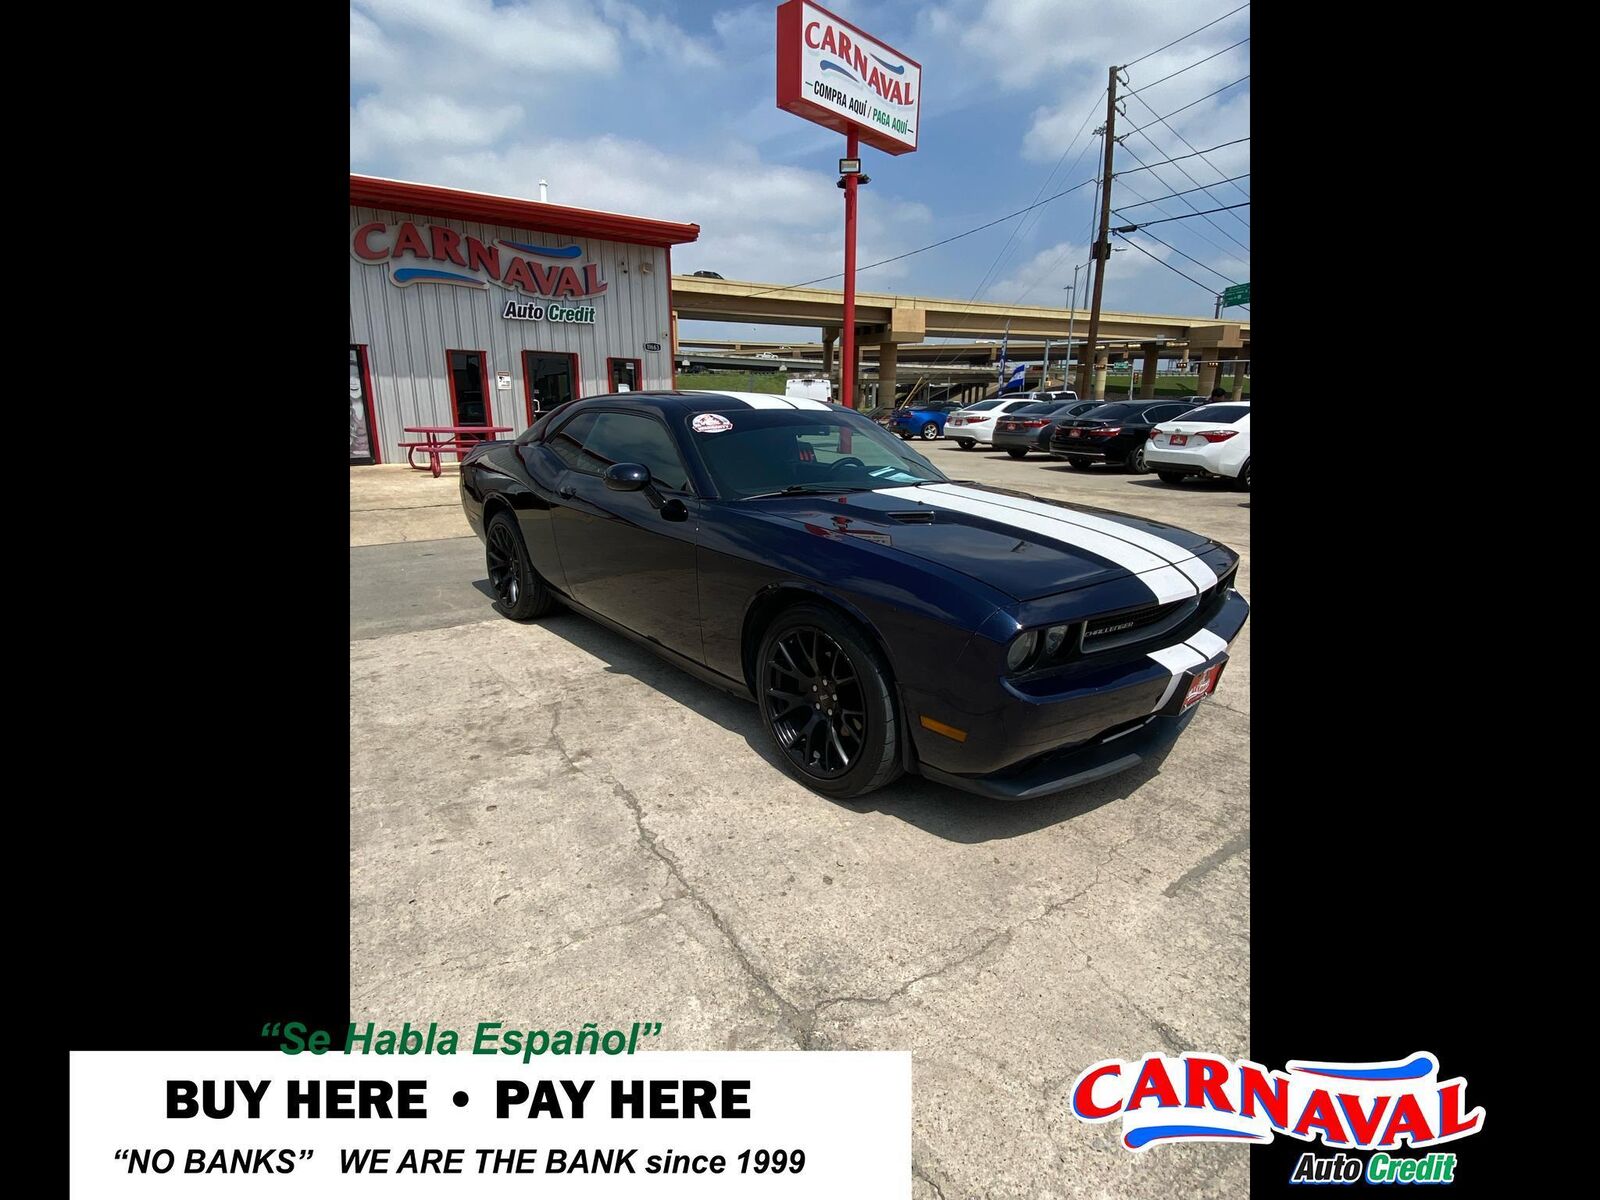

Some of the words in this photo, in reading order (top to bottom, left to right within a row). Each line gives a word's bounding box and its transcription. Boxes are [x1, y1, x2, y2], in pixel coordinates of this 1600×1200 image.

[805, 21, 915, 106] CARNAVAL
[813, 80, 847, 108] COMPRA
[848, 99, 868, 117] AQUÍ
[872, 108, 891, 127] PAGA
[891, 119, 909, 135] AQUÍ
[353, 222, 609, 297] CARNAVAL
[504, 301, 544, 320] Auto
[548, 304, 596, 323] Credit
[1084, 621, 1134, 638] CHALLENGER
